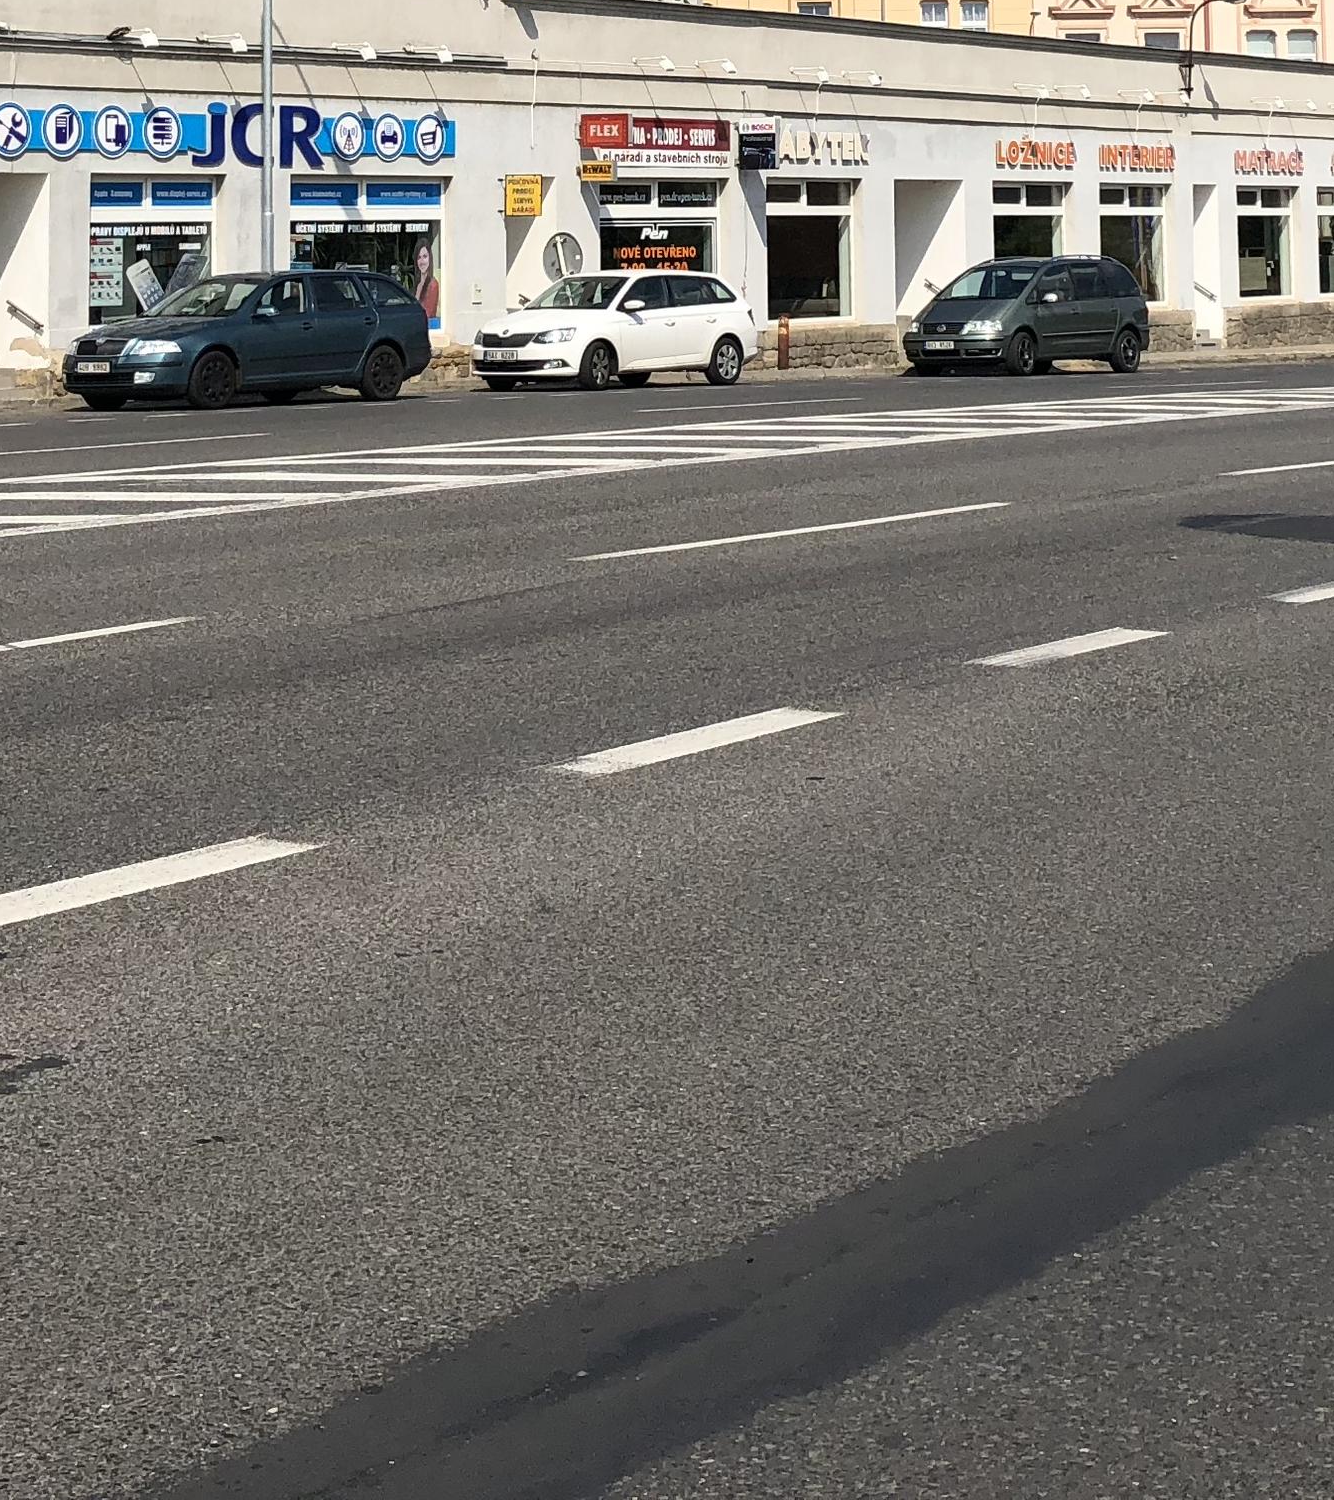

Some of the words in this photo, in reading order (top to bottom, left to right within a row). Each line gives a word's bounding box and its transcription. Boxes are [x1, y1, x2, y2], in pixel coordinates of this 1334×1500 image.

[589, 125, 619, 137] FLEX
[652, 127, 683, 146] PRODEJ
[690, 128, 716, 146] SERVIS
[779, 124, 870, 162] ÁBYTEK
[996, 134, 1075, 166] LOŽNICE
[645, 154, 651, 163] a
[654, 151, 701, 164] stavebních
[1099, 140, 1175, 169] INTERIÉR
[1234, 150, 1305, 172] MATRACE
[91, 226, 112, 236] PRAVY
[640, 227, 669, 240] Pen
[644, 244, 697, 258] OTEVŘENO
